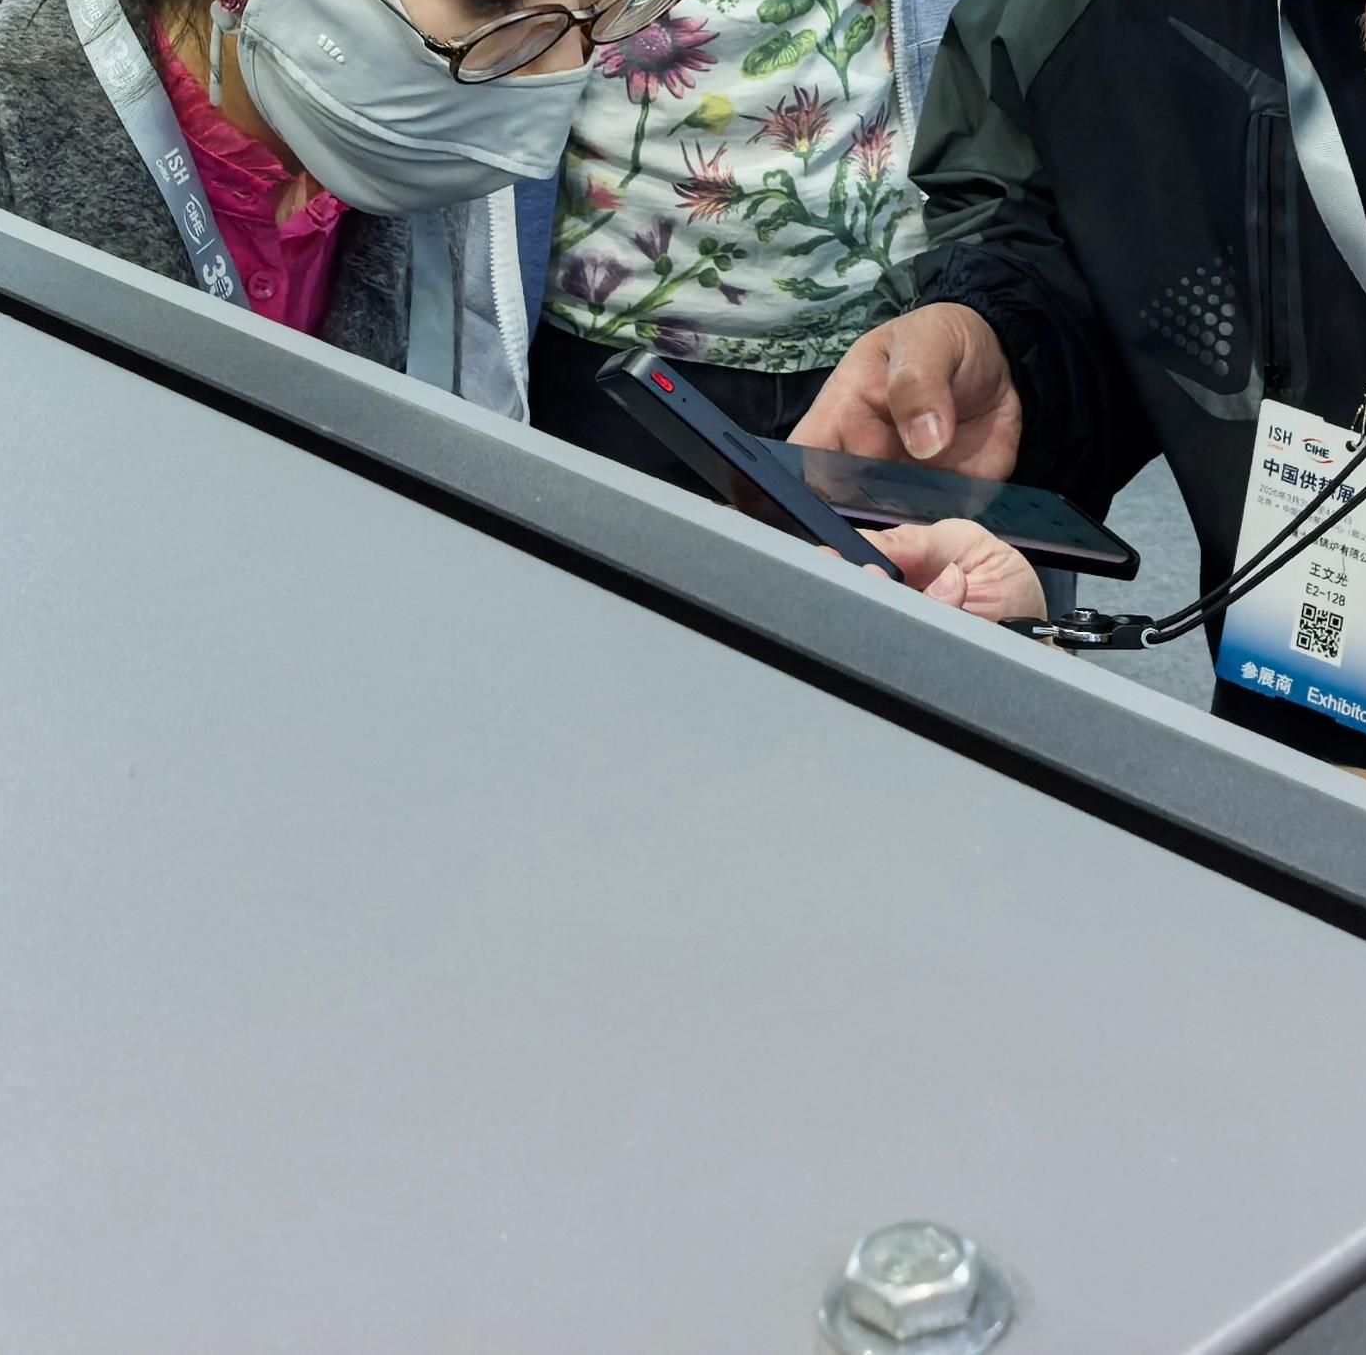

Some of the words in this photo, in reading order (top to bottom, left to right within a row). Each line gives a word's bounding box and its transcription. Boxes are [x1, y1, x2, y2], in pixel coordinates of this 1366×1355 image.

[155, 158, 170, 182] CHINA
[164, 148, 190, 186] ISH
[185, 200, 205, 238] CIHE
[1268, 425, 1293, 446] ISH
[1304, 442, 1330, 459] CIHE
[1309, 561, 1348, 587] 王文光
[1305, 582, 1346, 607] E2-12B
[1241, 661, 1294, 695] 参展商
